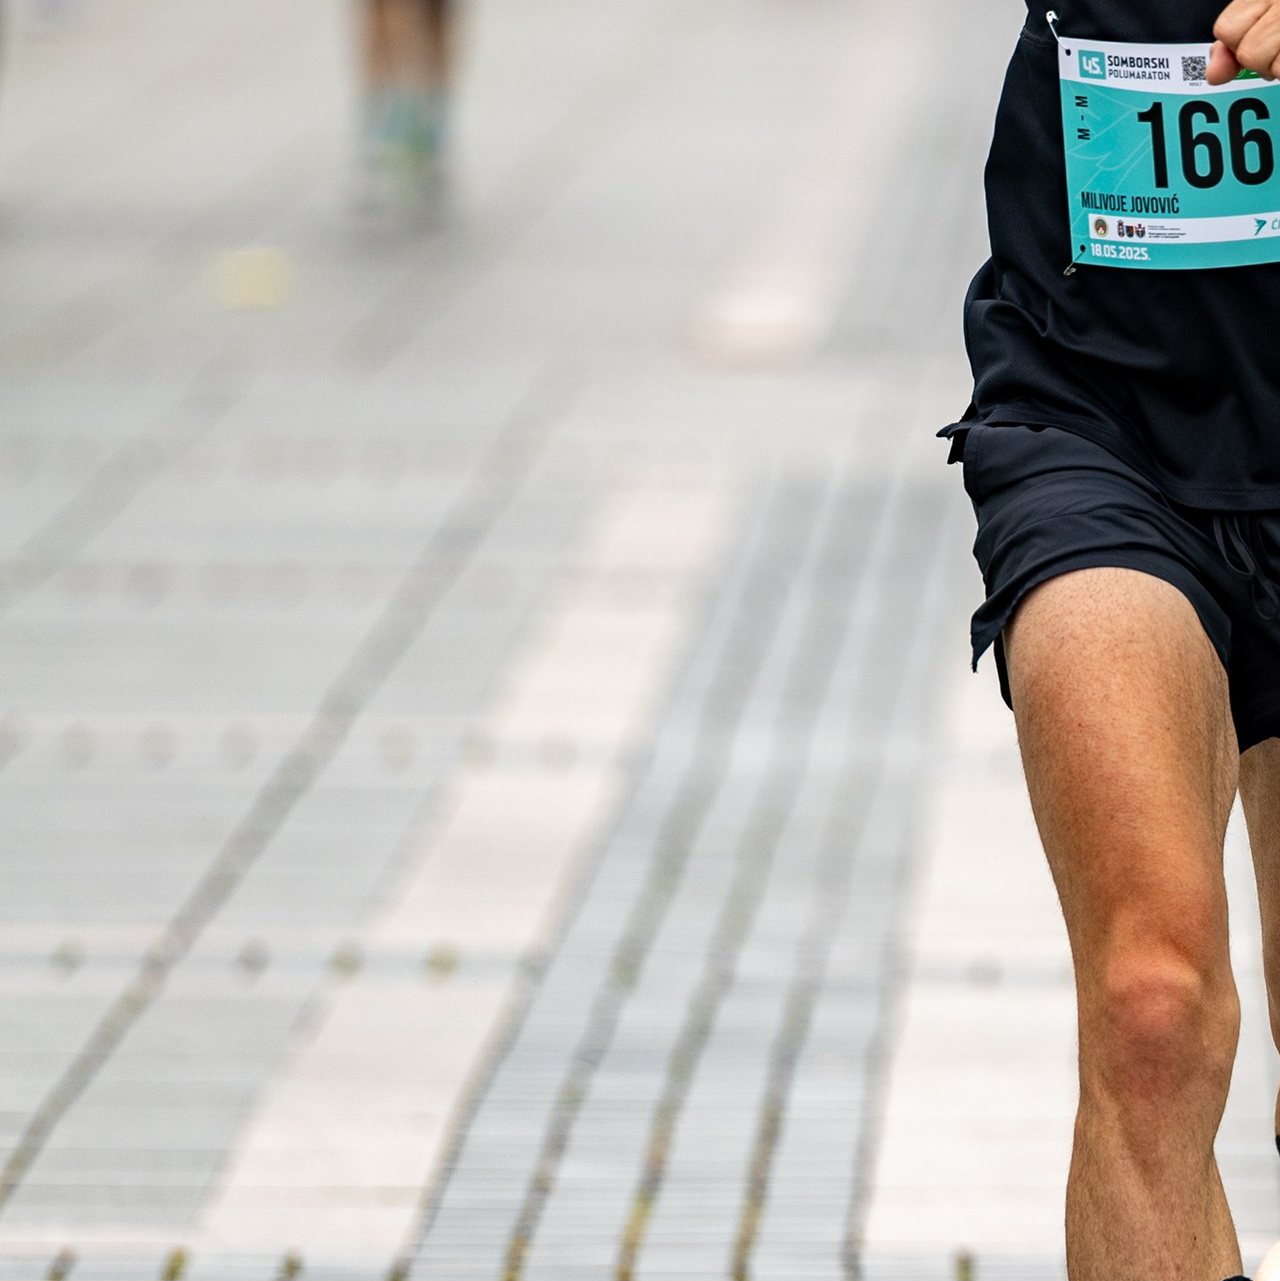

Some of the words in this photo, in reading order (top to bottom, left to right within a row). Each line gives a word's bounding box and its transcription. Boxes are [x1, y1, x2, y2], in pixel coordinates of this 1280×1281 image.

[1107, 54, 1170, 69] SOMBORSKI
[1108, 69, 1170, 81] POLUMARATON
[1137, 97, 1274, 189] 166
[1081, 191, 1128, 212] MILIVOJE
[1130, 193, 1180, 214] JOVOVIĆ
[1090, 242, 1152, 261] 18.05.2025.
